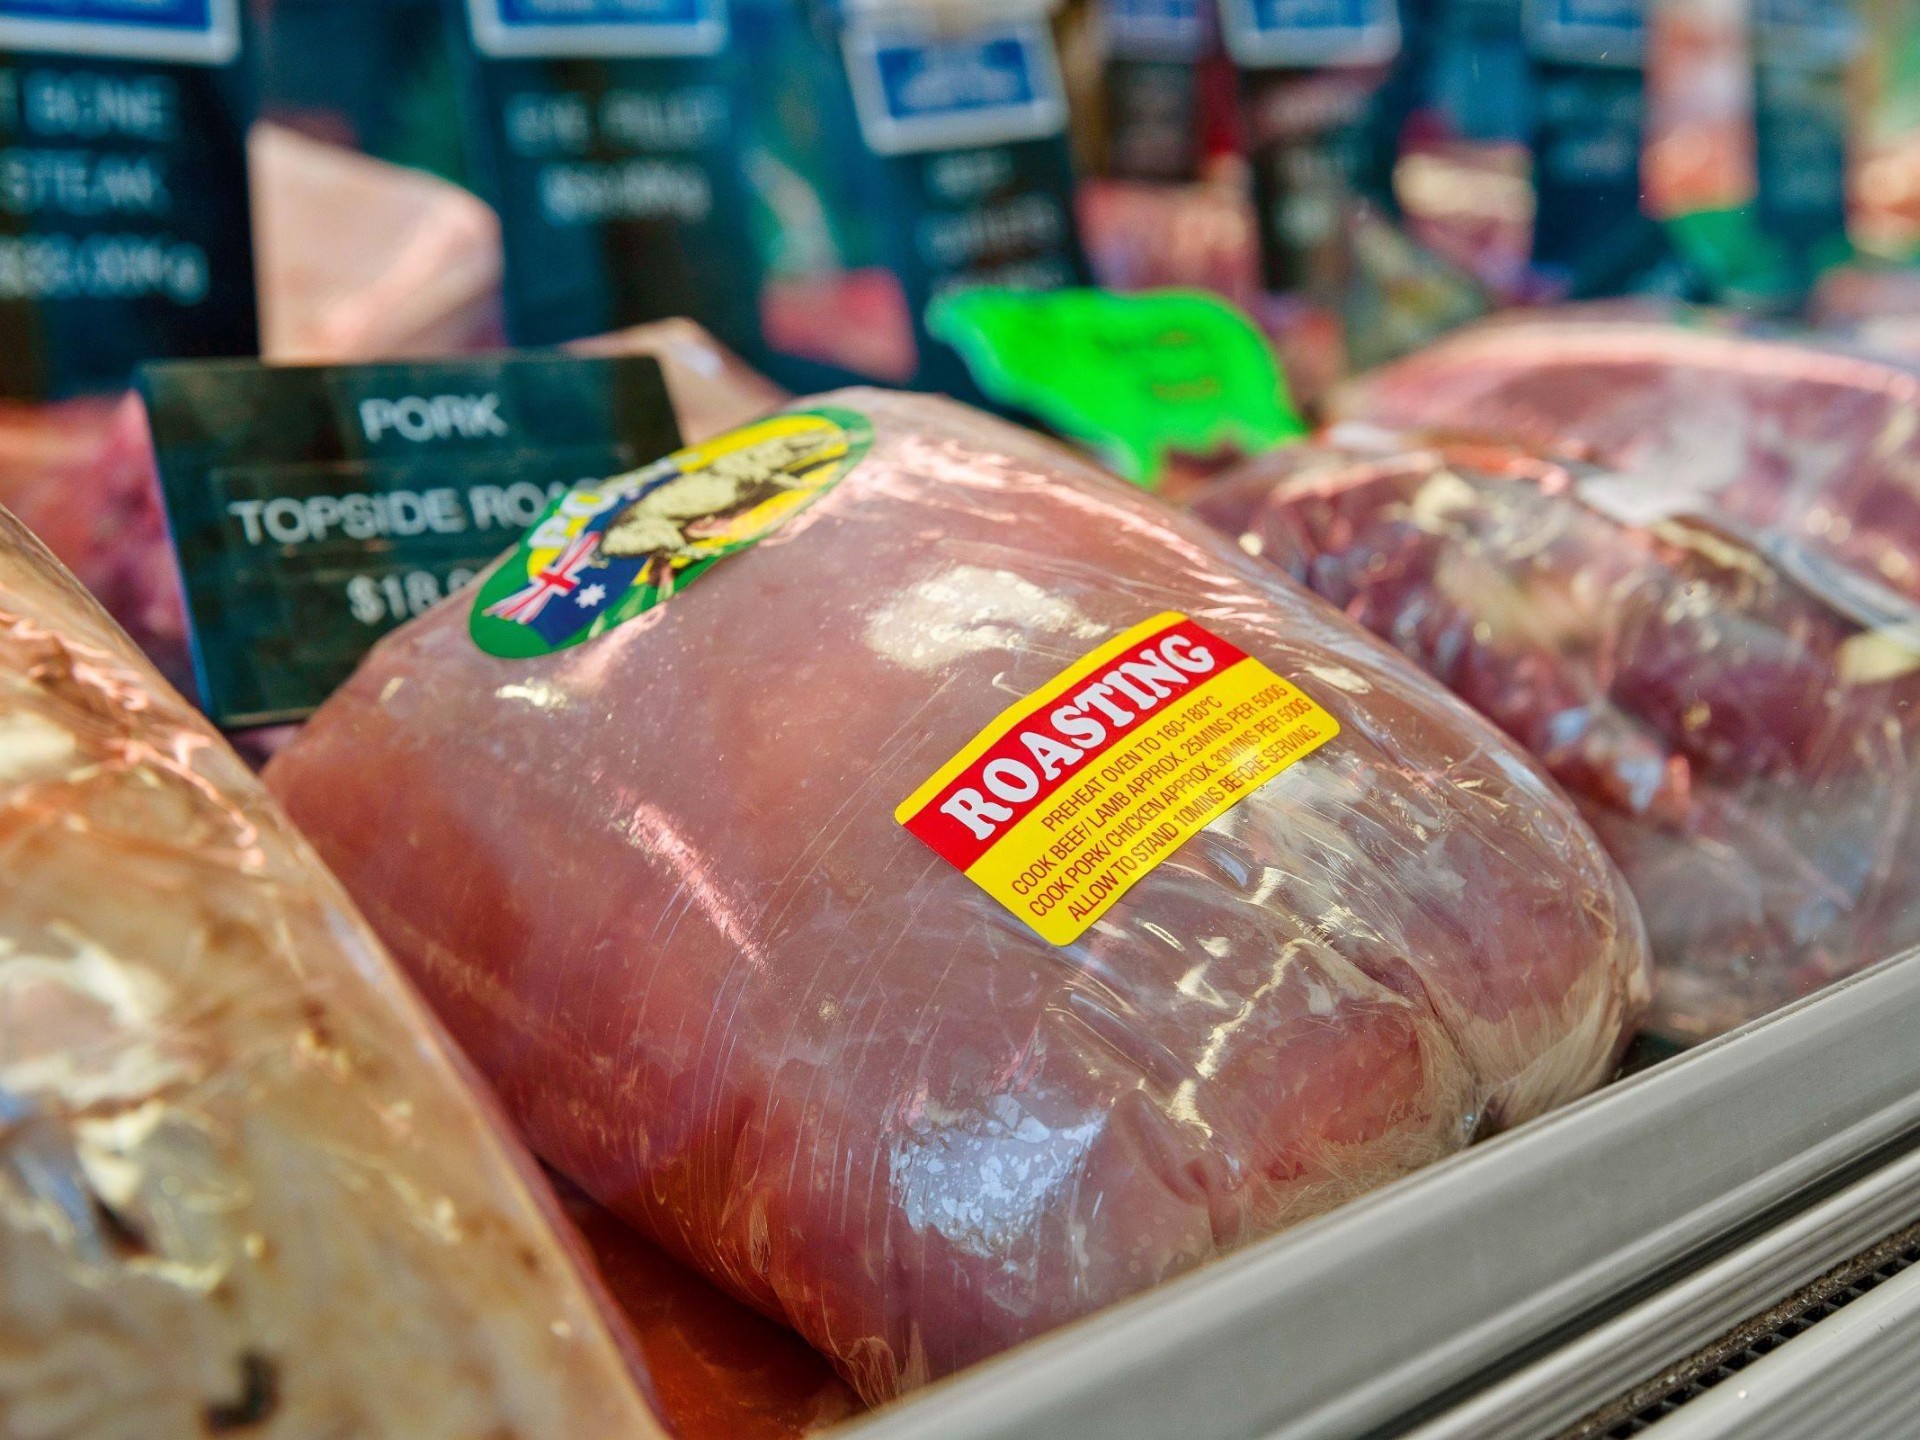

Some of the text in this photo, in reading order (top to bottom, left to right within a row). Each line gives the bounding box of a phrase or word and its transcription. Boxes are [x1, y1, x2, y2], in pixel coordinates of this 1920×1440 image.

[227, 487, 467, 547] TOPSIDE
[360, 393, 508, 442] PORK
[940, 634, 1215, 841] ROASTING
[1012, 683, 1290, 895] COOK BEEF/ LAMB APPROX. 25MINS PER 500G
[1029, 697, 1313, 917] COOK PORK/ CHICKEN APPROX. 30MINS PER 500G
[1041, 695, 1223, 832] PREHEAT OVEN TO 160-180°C
[1067, 723, 1321, 922] ALLOW TO STAND 10MINS BEFORE SERVING.
